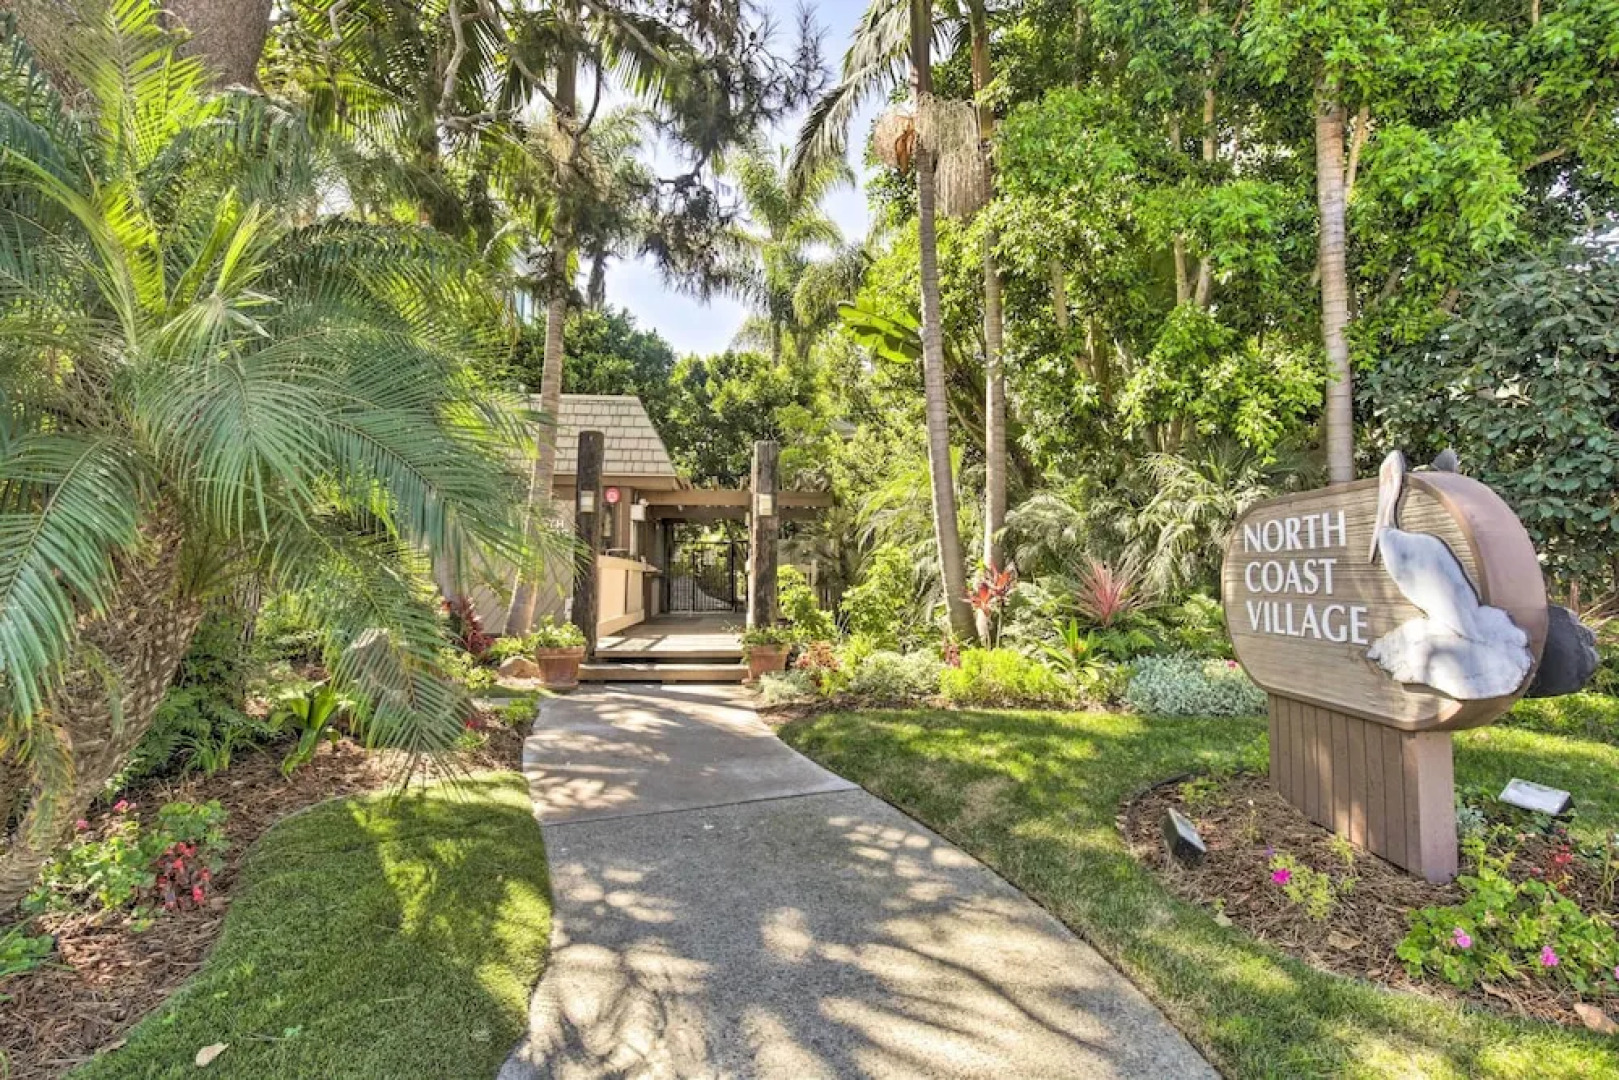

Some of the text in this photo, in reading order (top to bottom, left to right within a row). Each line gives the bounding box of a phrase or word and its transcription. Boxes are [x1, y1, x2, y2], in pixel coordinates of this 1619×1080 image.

[1244, 510, 1346, 552] NORTH
[1244, 558, 1337, 595] COAST
[1246, 600, 1369, 645] VILLAGE
